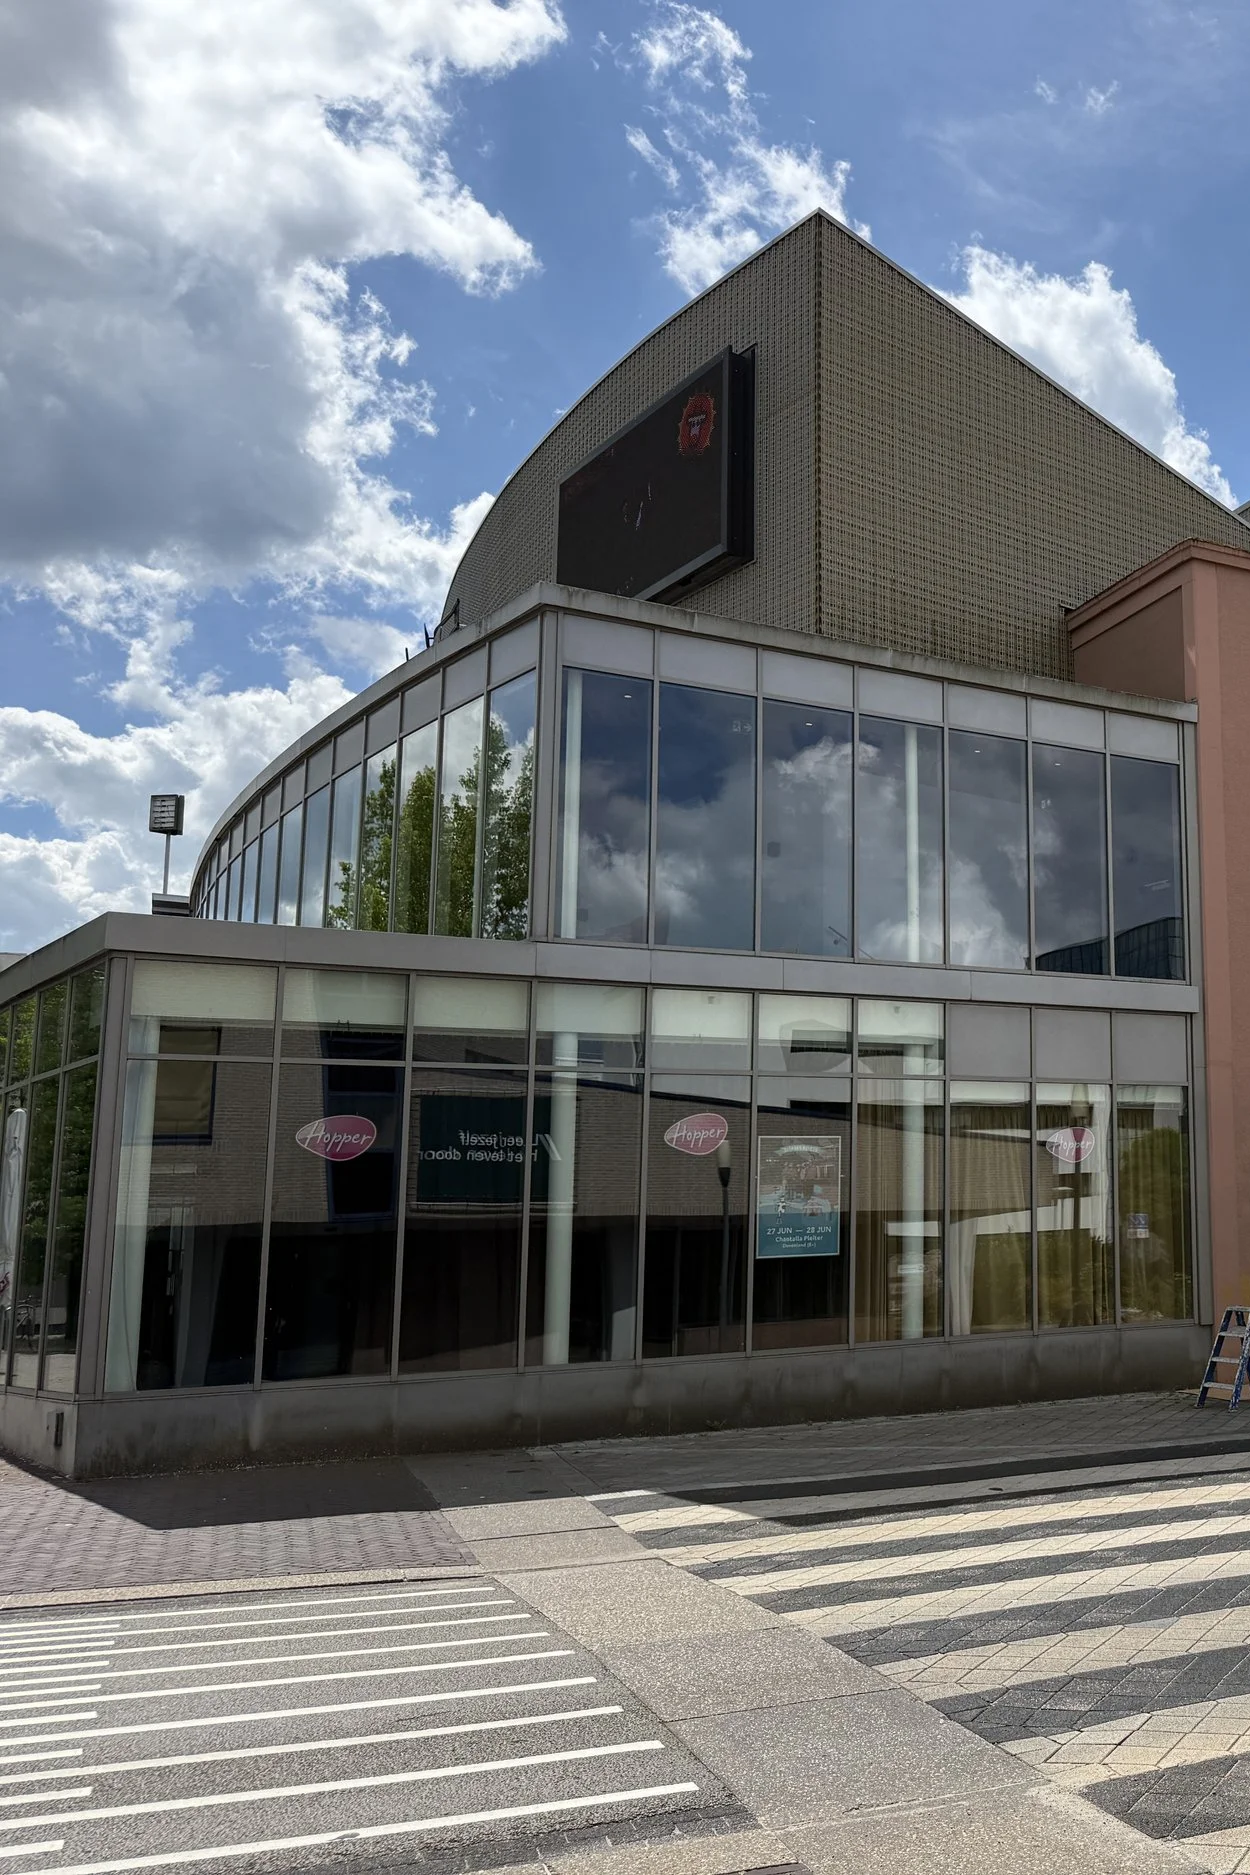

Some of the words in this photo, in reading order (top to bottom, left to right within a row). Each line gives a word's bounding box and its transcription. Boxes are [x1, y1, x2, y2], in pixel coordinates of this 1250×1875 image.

[303, 1120, 373, 1153] Hopper
[669, 1121, 725, 1149] Hopper
[1051, 1132, 1093, 1158] Hopper
[766, 1227, 776, 1235] 27
[777, 1227, 793, 1235] JUN
[806, 1226, 816, 1234] 28
[816, 1226, 832, 1234] JUN
